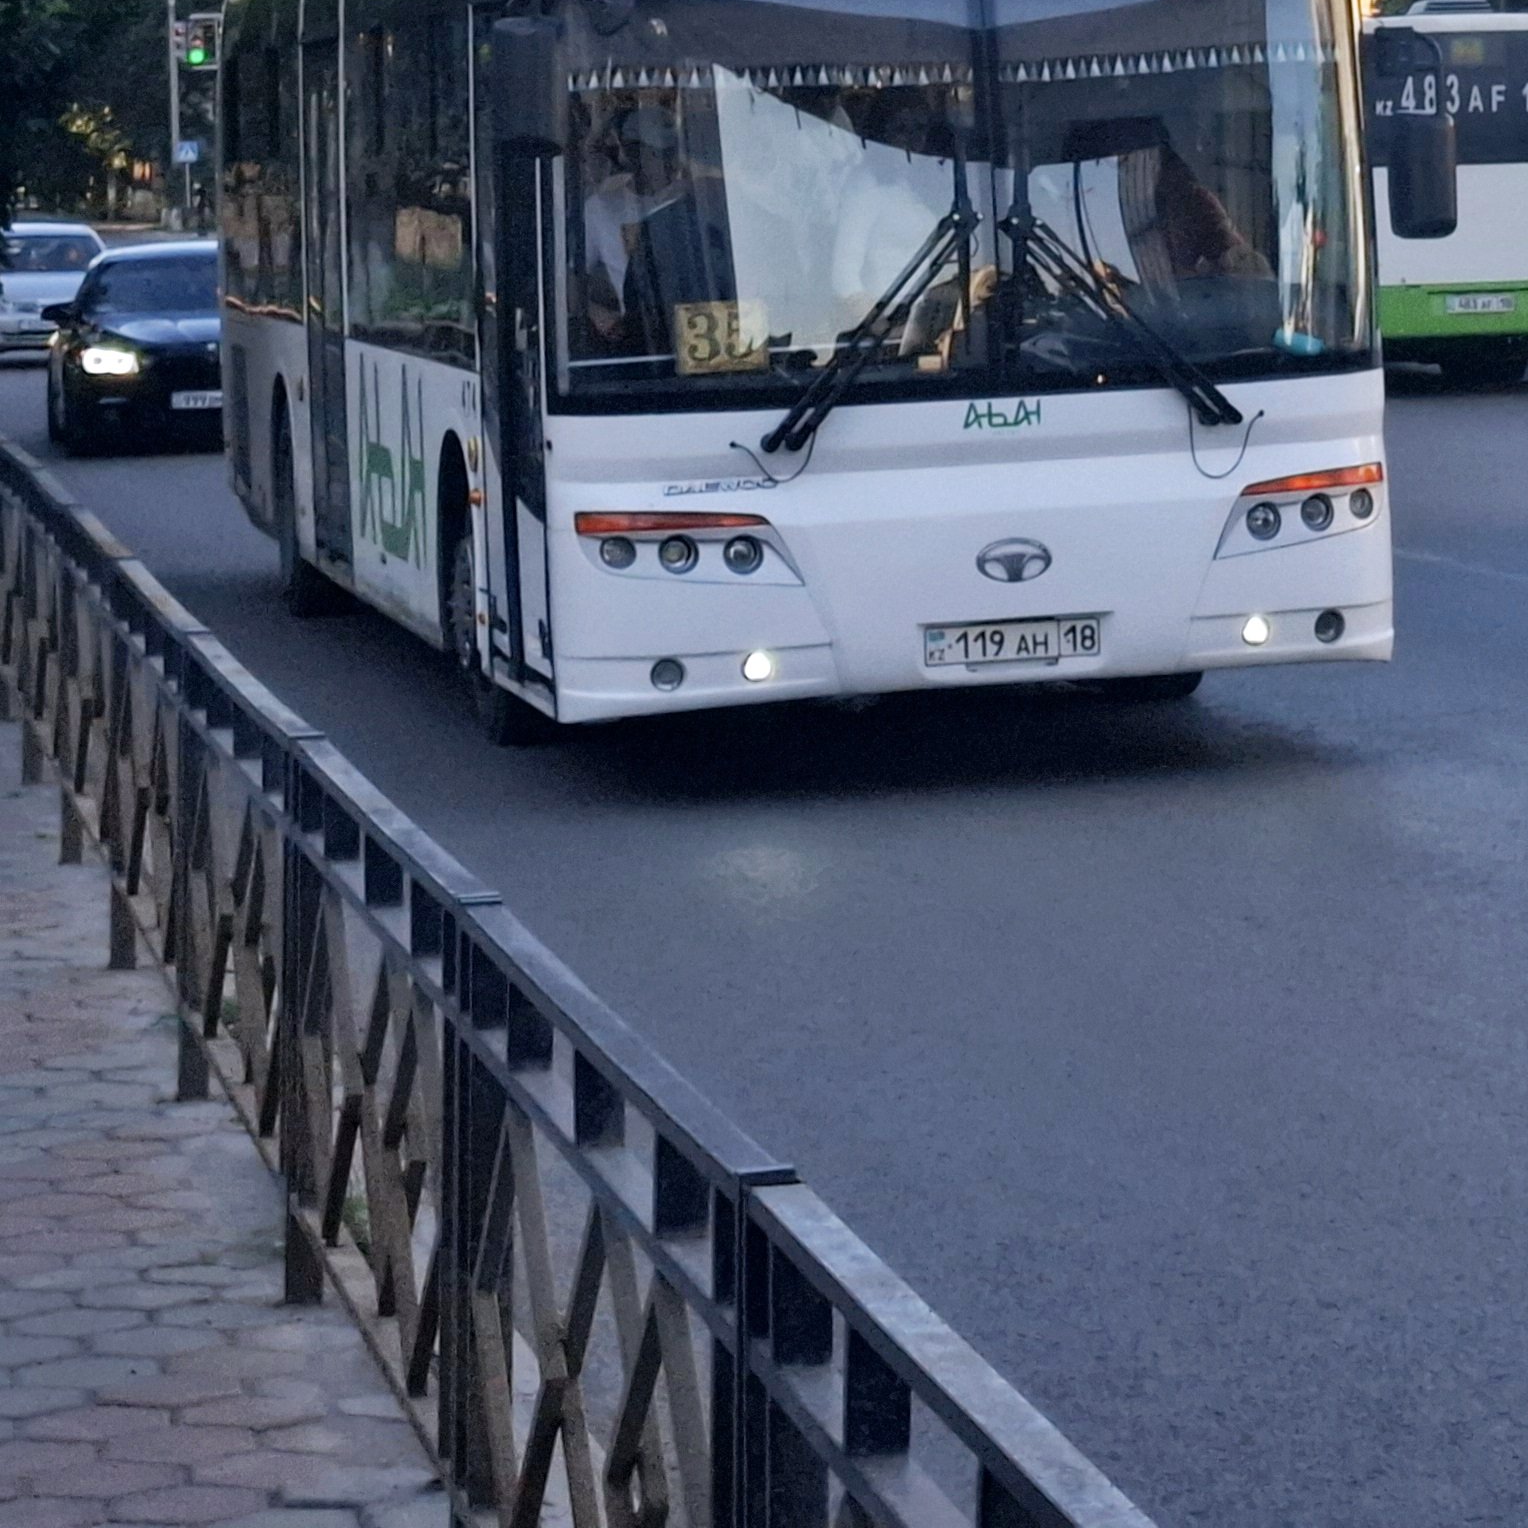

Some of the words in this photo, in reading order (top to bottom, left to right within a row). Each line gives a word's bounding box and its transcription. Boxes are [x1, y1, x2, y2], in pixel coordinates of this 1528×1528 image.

[1375, 100, 1394, 116] KZ
[1401, 74, 1460, 114] 483
[1468, 84, 1507, 113] AF
[928, 648, 945, 662] KZ
[955, 629, 1005, 660] 119
[1016, 633, 1049, 656] AH
[1063, 624, 1097, 653] 18
